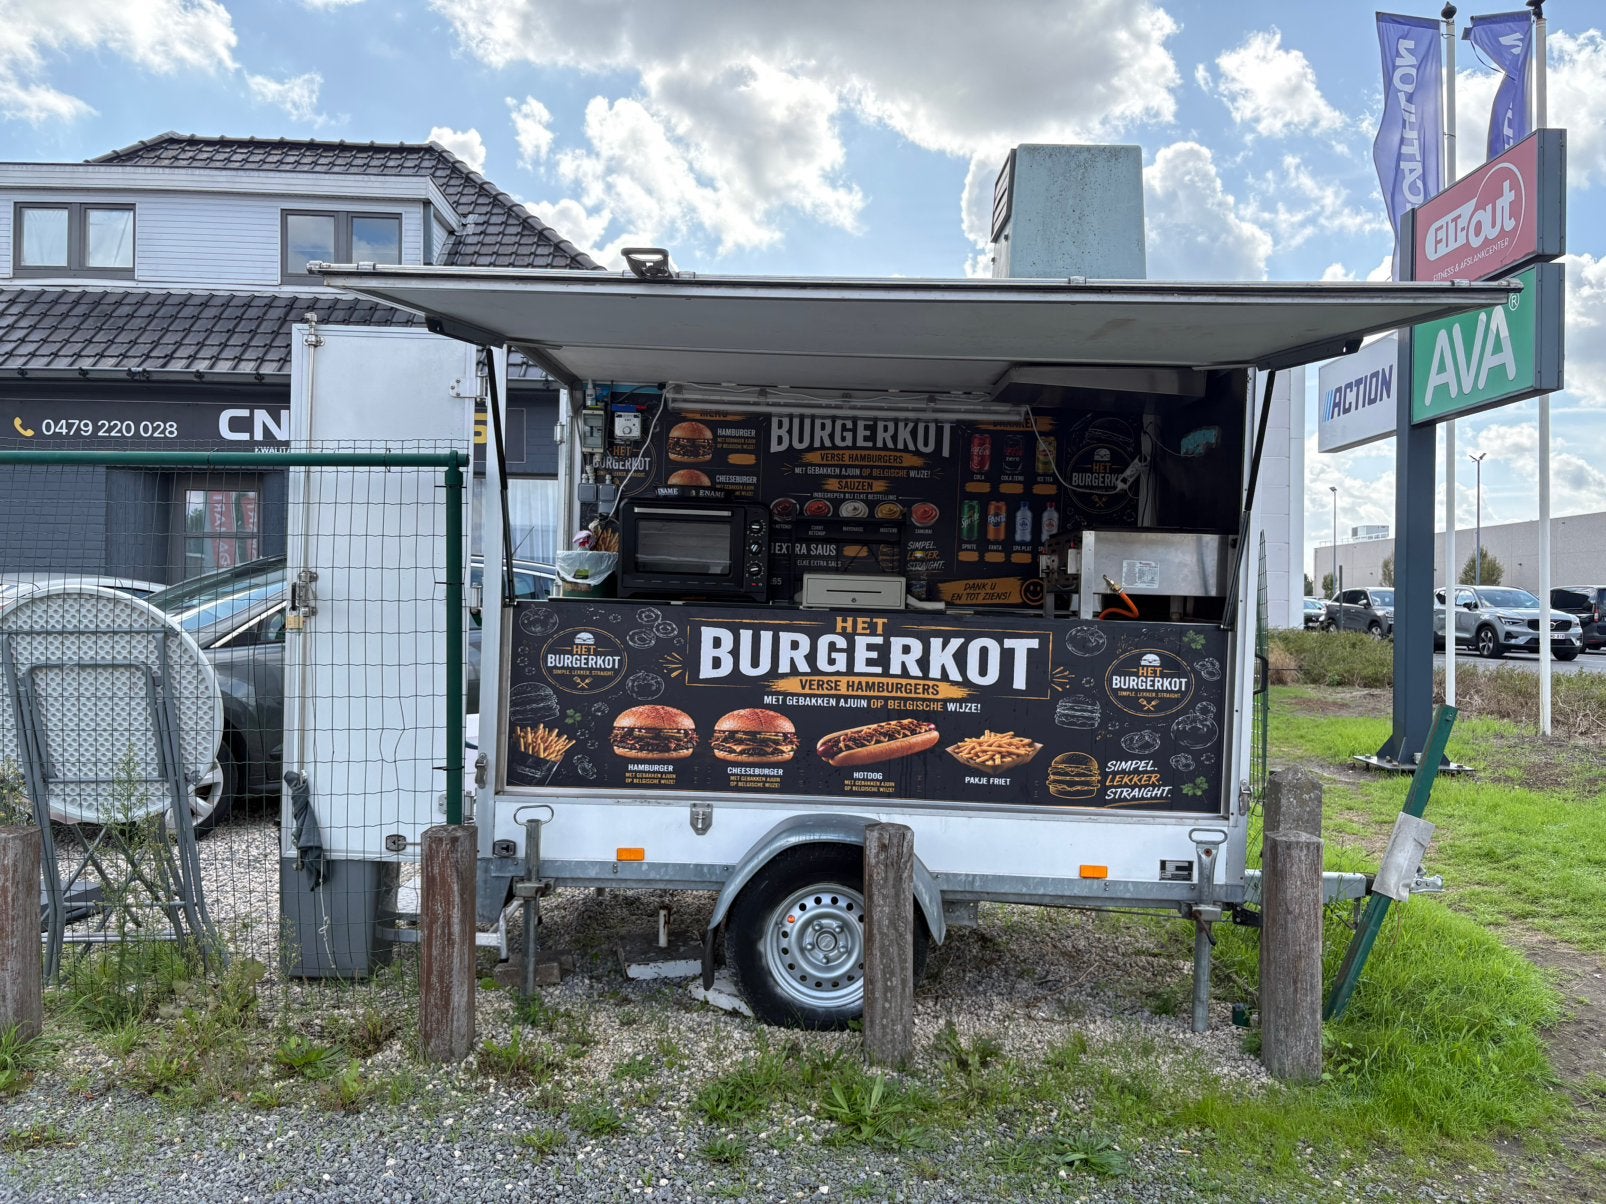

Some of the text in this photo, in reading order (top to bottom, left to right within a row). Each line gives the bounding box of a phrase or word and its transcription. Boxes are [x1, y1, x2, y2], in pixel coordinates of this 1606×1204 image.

[1433, 266, 1454, 281] FITNESS
[1424, 305, 1516, 407] AVA
[1330, 364, 1393, 420] ACTION
[42, 419, 178, 438] 0479 220 028
[718, 428, 756, 437] HAMBURGER
[770, 417, 951, 458] BURGERKOT
[820, 452, 904, 464] VERSE HAMBURGERS
[807, 466, 840, 475] GEBAKKEN
[841, 467, 860, 476] AJUIN
[862, 468, 870, 476] OP
[872, 468, 908, 478] BELGISCHE
[1092, 463, 1111, 472] HET
[716, 475, 757, 484] CHEESEBURGER
[837, 480, 873, 491] SAUZEN
[1072, 472, 1120, 487] BURGERK
[810, 543, 837, 556] SAUS
[907, 551, 940, 560] LEKER.
[963, 583, 988, 591] DANK
[951, 591, 1012, 601] EN TOT ZIENS!
[835, 616, 888, 635] HET
[573, 645, 597, 655] HET
[547, 654, 621, 669] BURGERKOT
[699, 626, 1039, 690] BURGERKOT
[1138, 666, 1163, 677] HET
[799, 679, 940, 696] VERSE HAMBURGERS
[1112, 675, 1188, 691] BURGERKOT
[763, 695, 981, 713] MET GEBAKKEN AJUIN OP BELGISCHE WIJZE!
[628, 763, 674, 772] HAMBURGER
[727, 766, 783, 776] CHEESEBURGER
[1106, 760, 1158, 772] SIMPEL.
[853, 771, 883, 780] HOTDOG
[965, 776, 1011, 786] PAKJE FRIET
[1106, 774, 1163, 786] LEKKER.
[1105, 786, 1173, 800] STRAIGHT.
